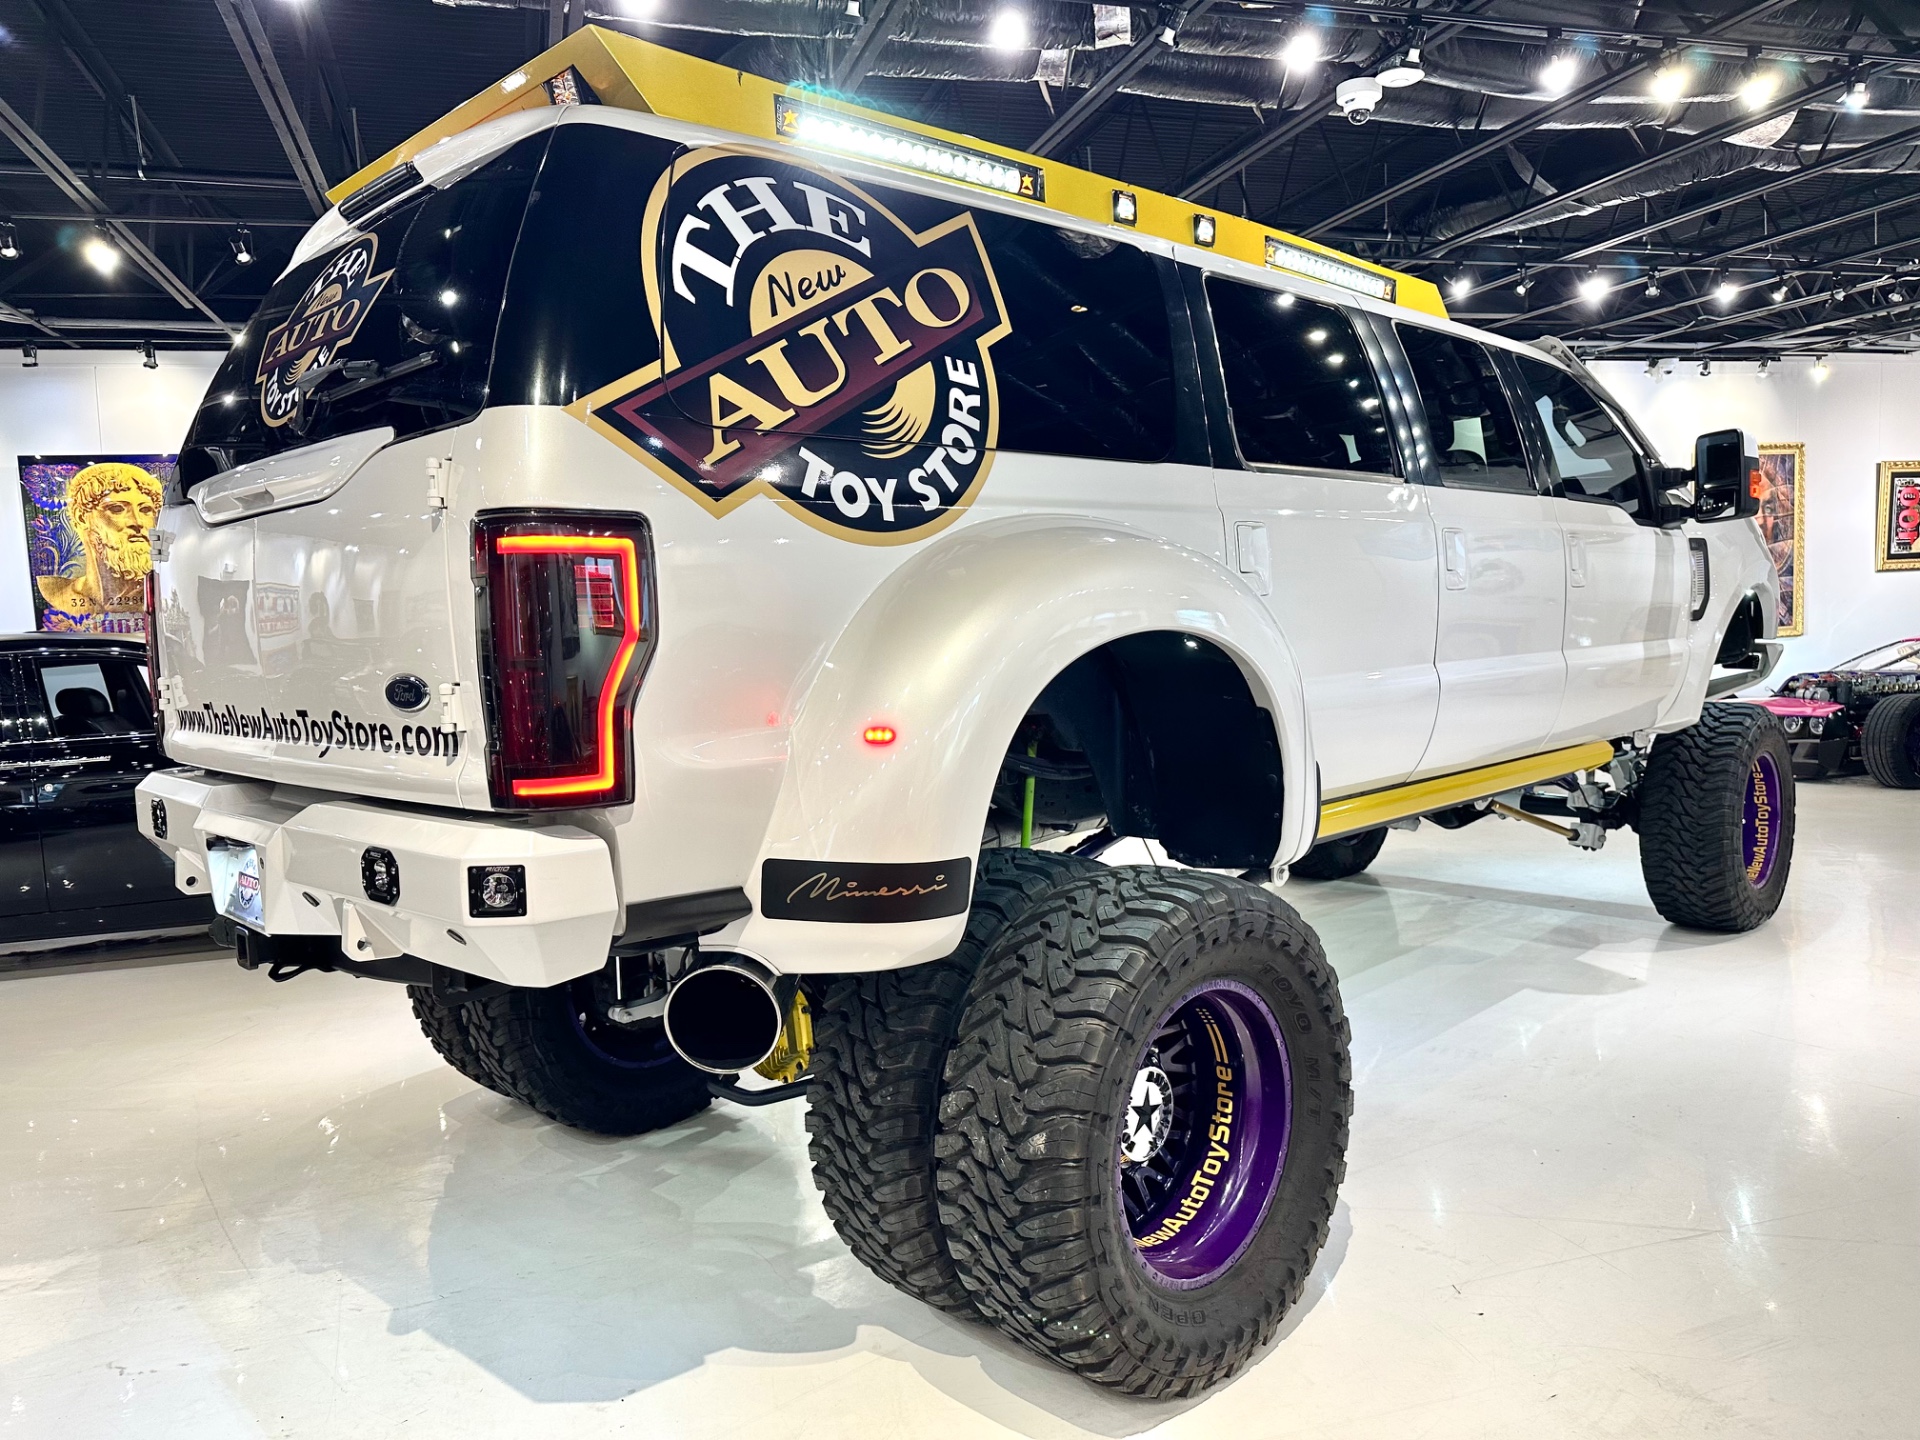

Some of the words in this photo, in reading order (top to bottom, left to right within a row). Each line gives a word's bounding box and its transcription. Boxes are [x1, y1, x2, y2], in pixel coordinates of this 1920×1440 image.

[671, 176, 872, 307] THE
[305, 247, 368, 306] THE
[766, 264, 847, 319] New
[265, 298, 361, 364] AUTO
[266, 366, 282, 413] TOY
[702, 268, 970, 466] AUTO
[798, 446, 899, 522] TOY
[907, 355, 982, 512] STORE
[393, 683, 416, 702] Ford
[177, 702, 459, 758] www.TheNewAutoToyStore.com
[239, 874, 259, 891] AUTO
